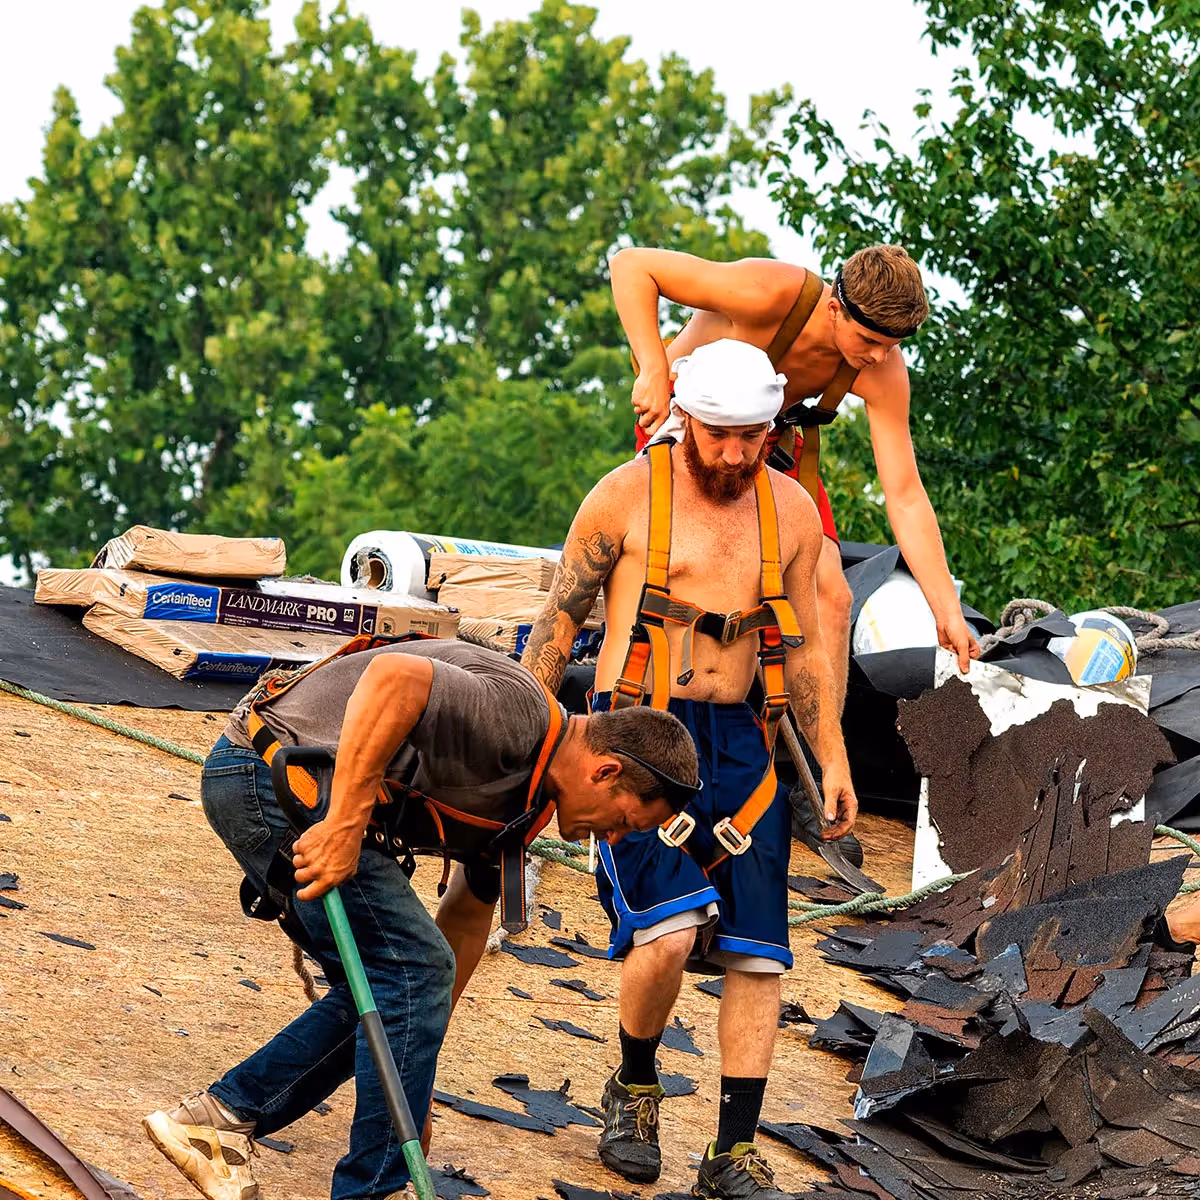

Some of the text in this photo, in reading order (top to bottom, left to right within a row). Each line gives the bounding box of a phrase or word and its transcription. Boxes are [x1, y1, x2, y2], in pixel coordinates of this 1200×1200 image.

[152, 591, 212, 608] CertainTeed
[225, 593, 338, 622] LANDMARK PRO
[344, 609, 354, 617] AR
[197, 660, 262, 674] CertainTeed
